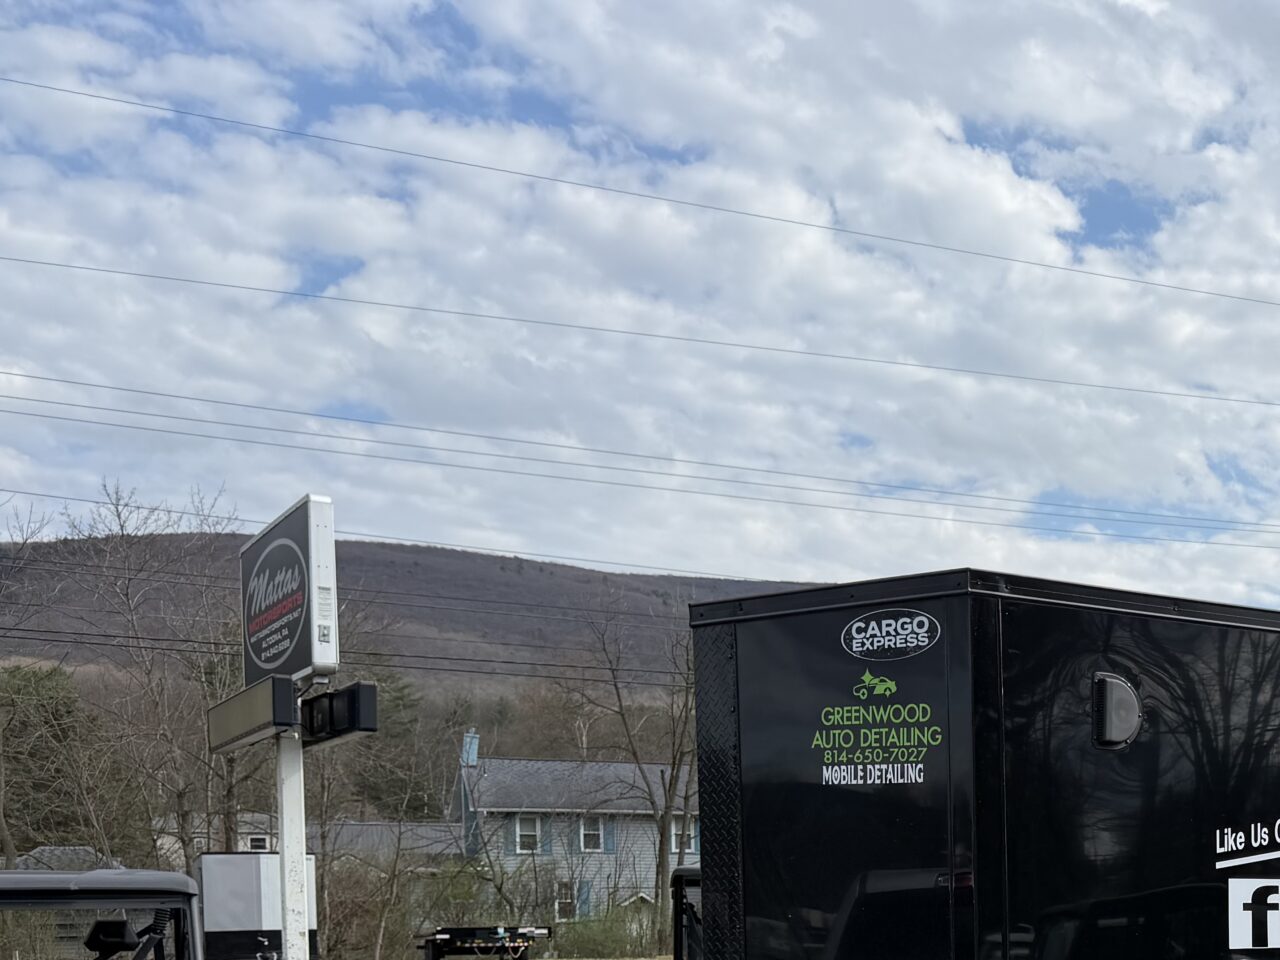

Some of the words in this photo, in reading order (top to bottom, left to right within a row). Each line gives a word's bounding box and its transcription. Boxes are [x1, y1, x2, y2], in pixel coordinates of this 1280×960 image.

[250, 563, 301, 617] Mattas
[249, 591, 303, 634] MOTORSPORTS
[851, 616, 929, 640] CARGO
[852, 633, 929, 652] EXPRESS
[821, 703, 931, 726] GREENWOOD
[811, 729, 854, 749] AUTO
[860, 726, 943, 748] DETAILING
[824, 748, 928, 764] 814-650-7027
[822, 764, 864, 786] MOBILE
[866, 763, 924, 785] DETAILING
[1216, 828, 1246, 854] Like
[1250, 822, 1269, 848] Us
